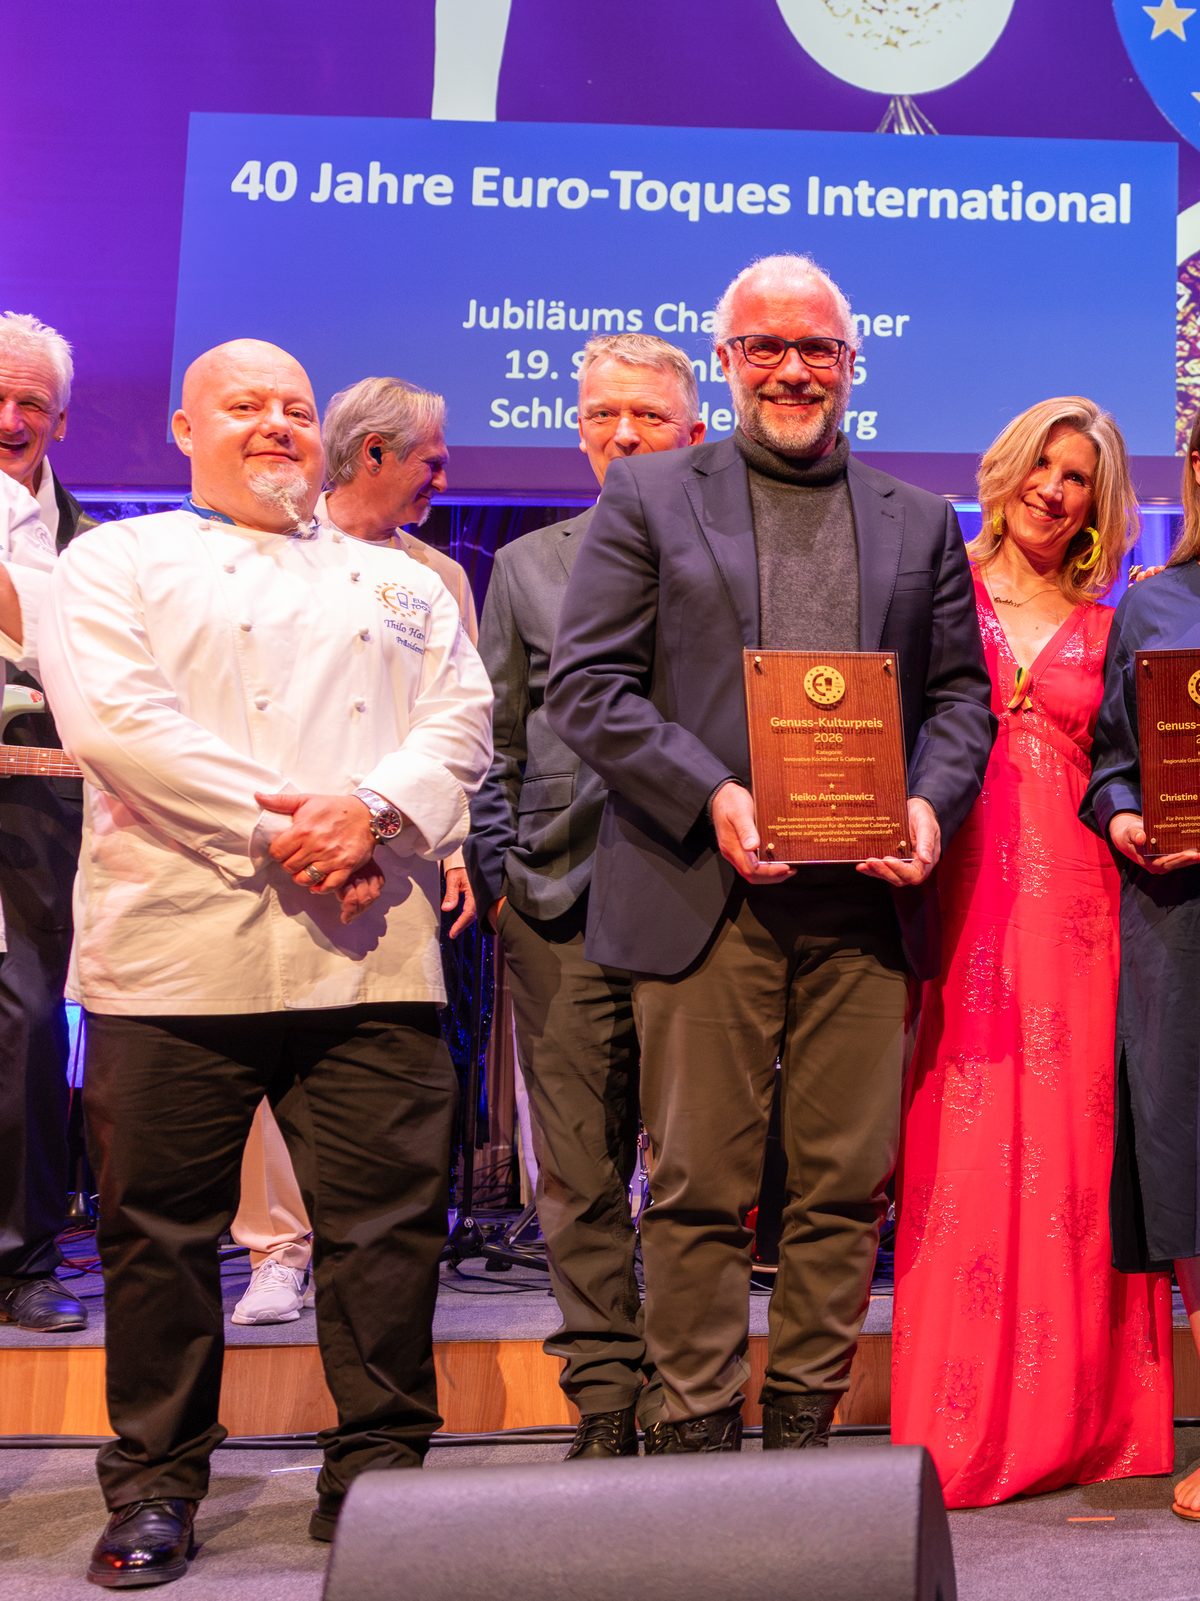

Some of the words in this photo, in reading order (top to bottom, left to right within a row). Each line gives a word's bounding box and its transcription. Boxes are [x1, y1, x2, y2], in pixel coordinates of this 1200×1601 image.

[230, 160, 299, 203] 40
[309, 161, 455, 206] Jahre
[470, 167, 791, 222] Euro-Toques
[807, 176, 1131, 224] International
[462, 297, 643, 332] Jubiläums
[505, 348, 559, 380] 19.
[488, 397, 580, 430] Schlo
[384, 619, 407, 633] Thilo
[770, 717, 883, 729] Genuss-Kulturpreis
[814, 733, 843, 742] 2026
[790, 793, 816, 801] Heiko
[818, 792, 874, 801] Antoniewicz
[1160, 792, 1198, 802] Christine
